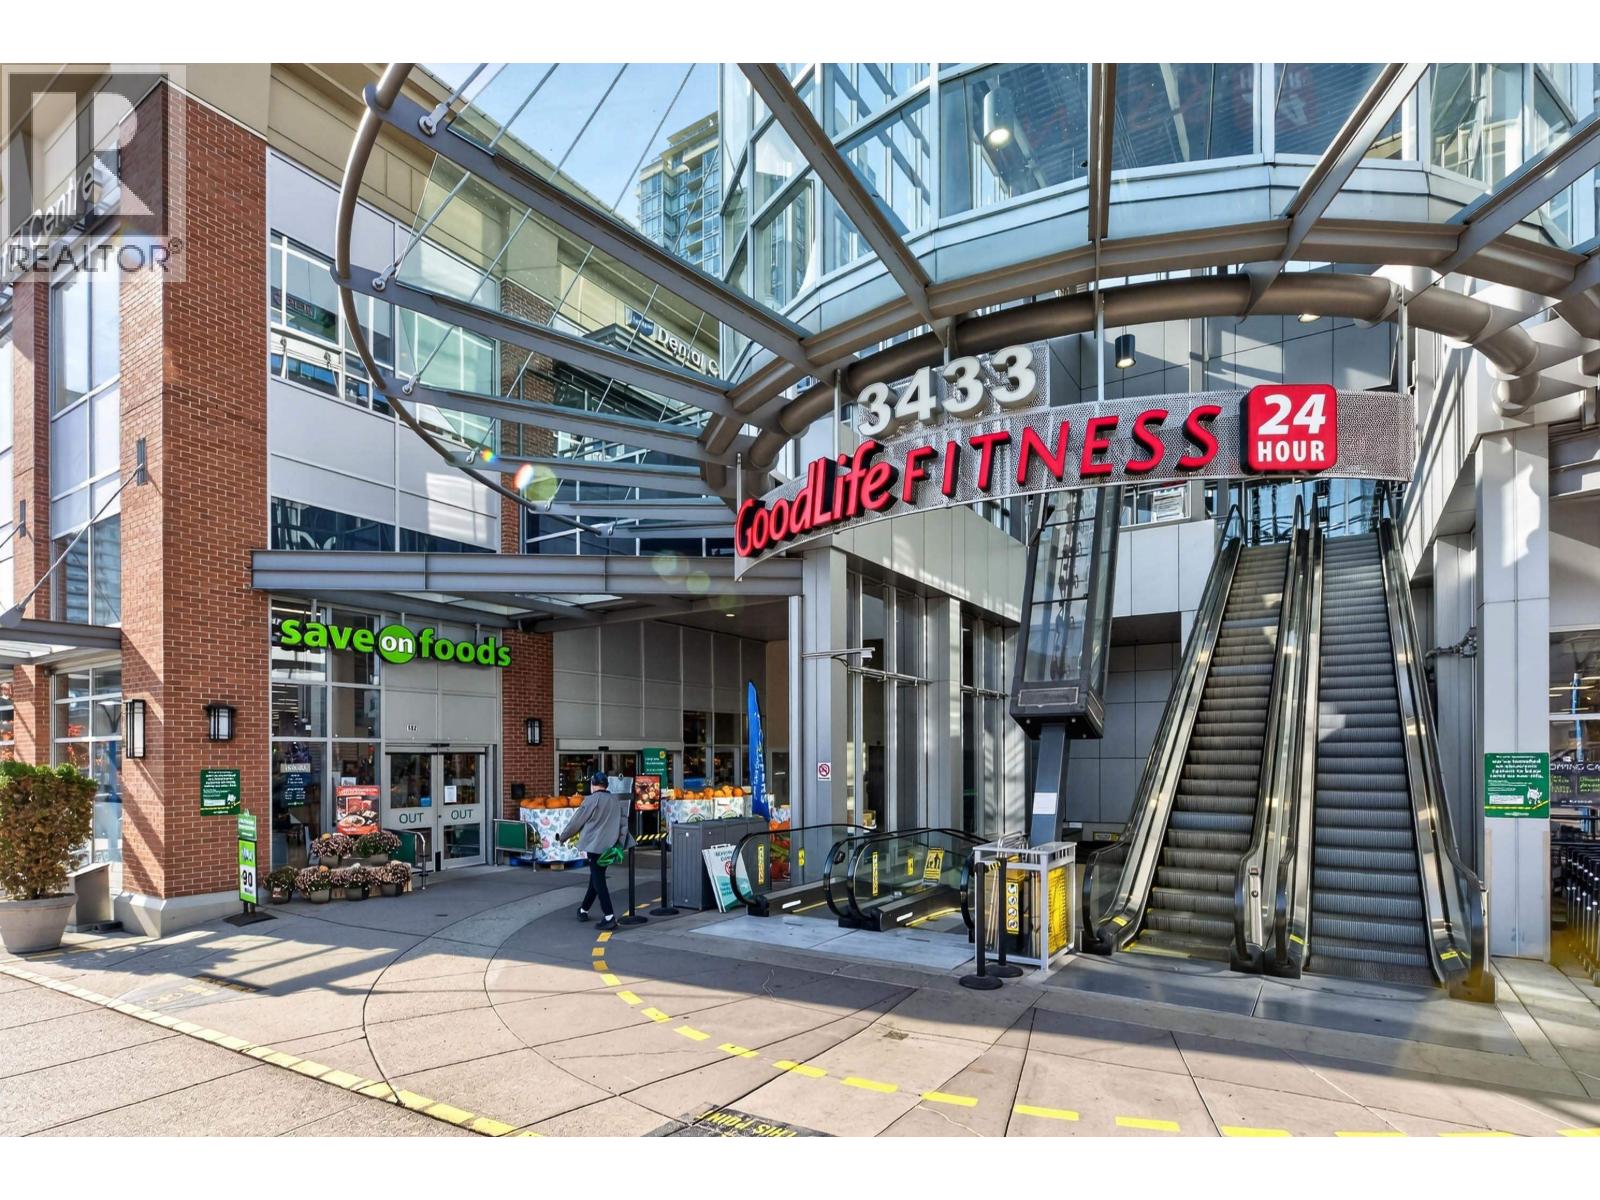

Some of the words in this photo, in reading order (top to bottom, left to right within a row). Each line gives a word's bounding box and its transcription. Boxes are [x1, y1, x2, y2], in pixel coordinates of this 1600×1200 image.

[657, 326, 705, 368] Dental
[856, 343, 1037, 437] 3433
[1258, 394, 1326, 435] 24
[1258, 440, 1325, 463] HOUR
[734, 440, 893, 558] GoodLife
[902, 404, 1223, 503] FITNESS
[280, 618, 376, 654] save
[380, 636, 414, 653] on
[419, 627, 512, 667] foods
[399, 813, 425, 825] OUT
[451, 809, 474, 820] OUT
[241, 869, 254, 888] 90
